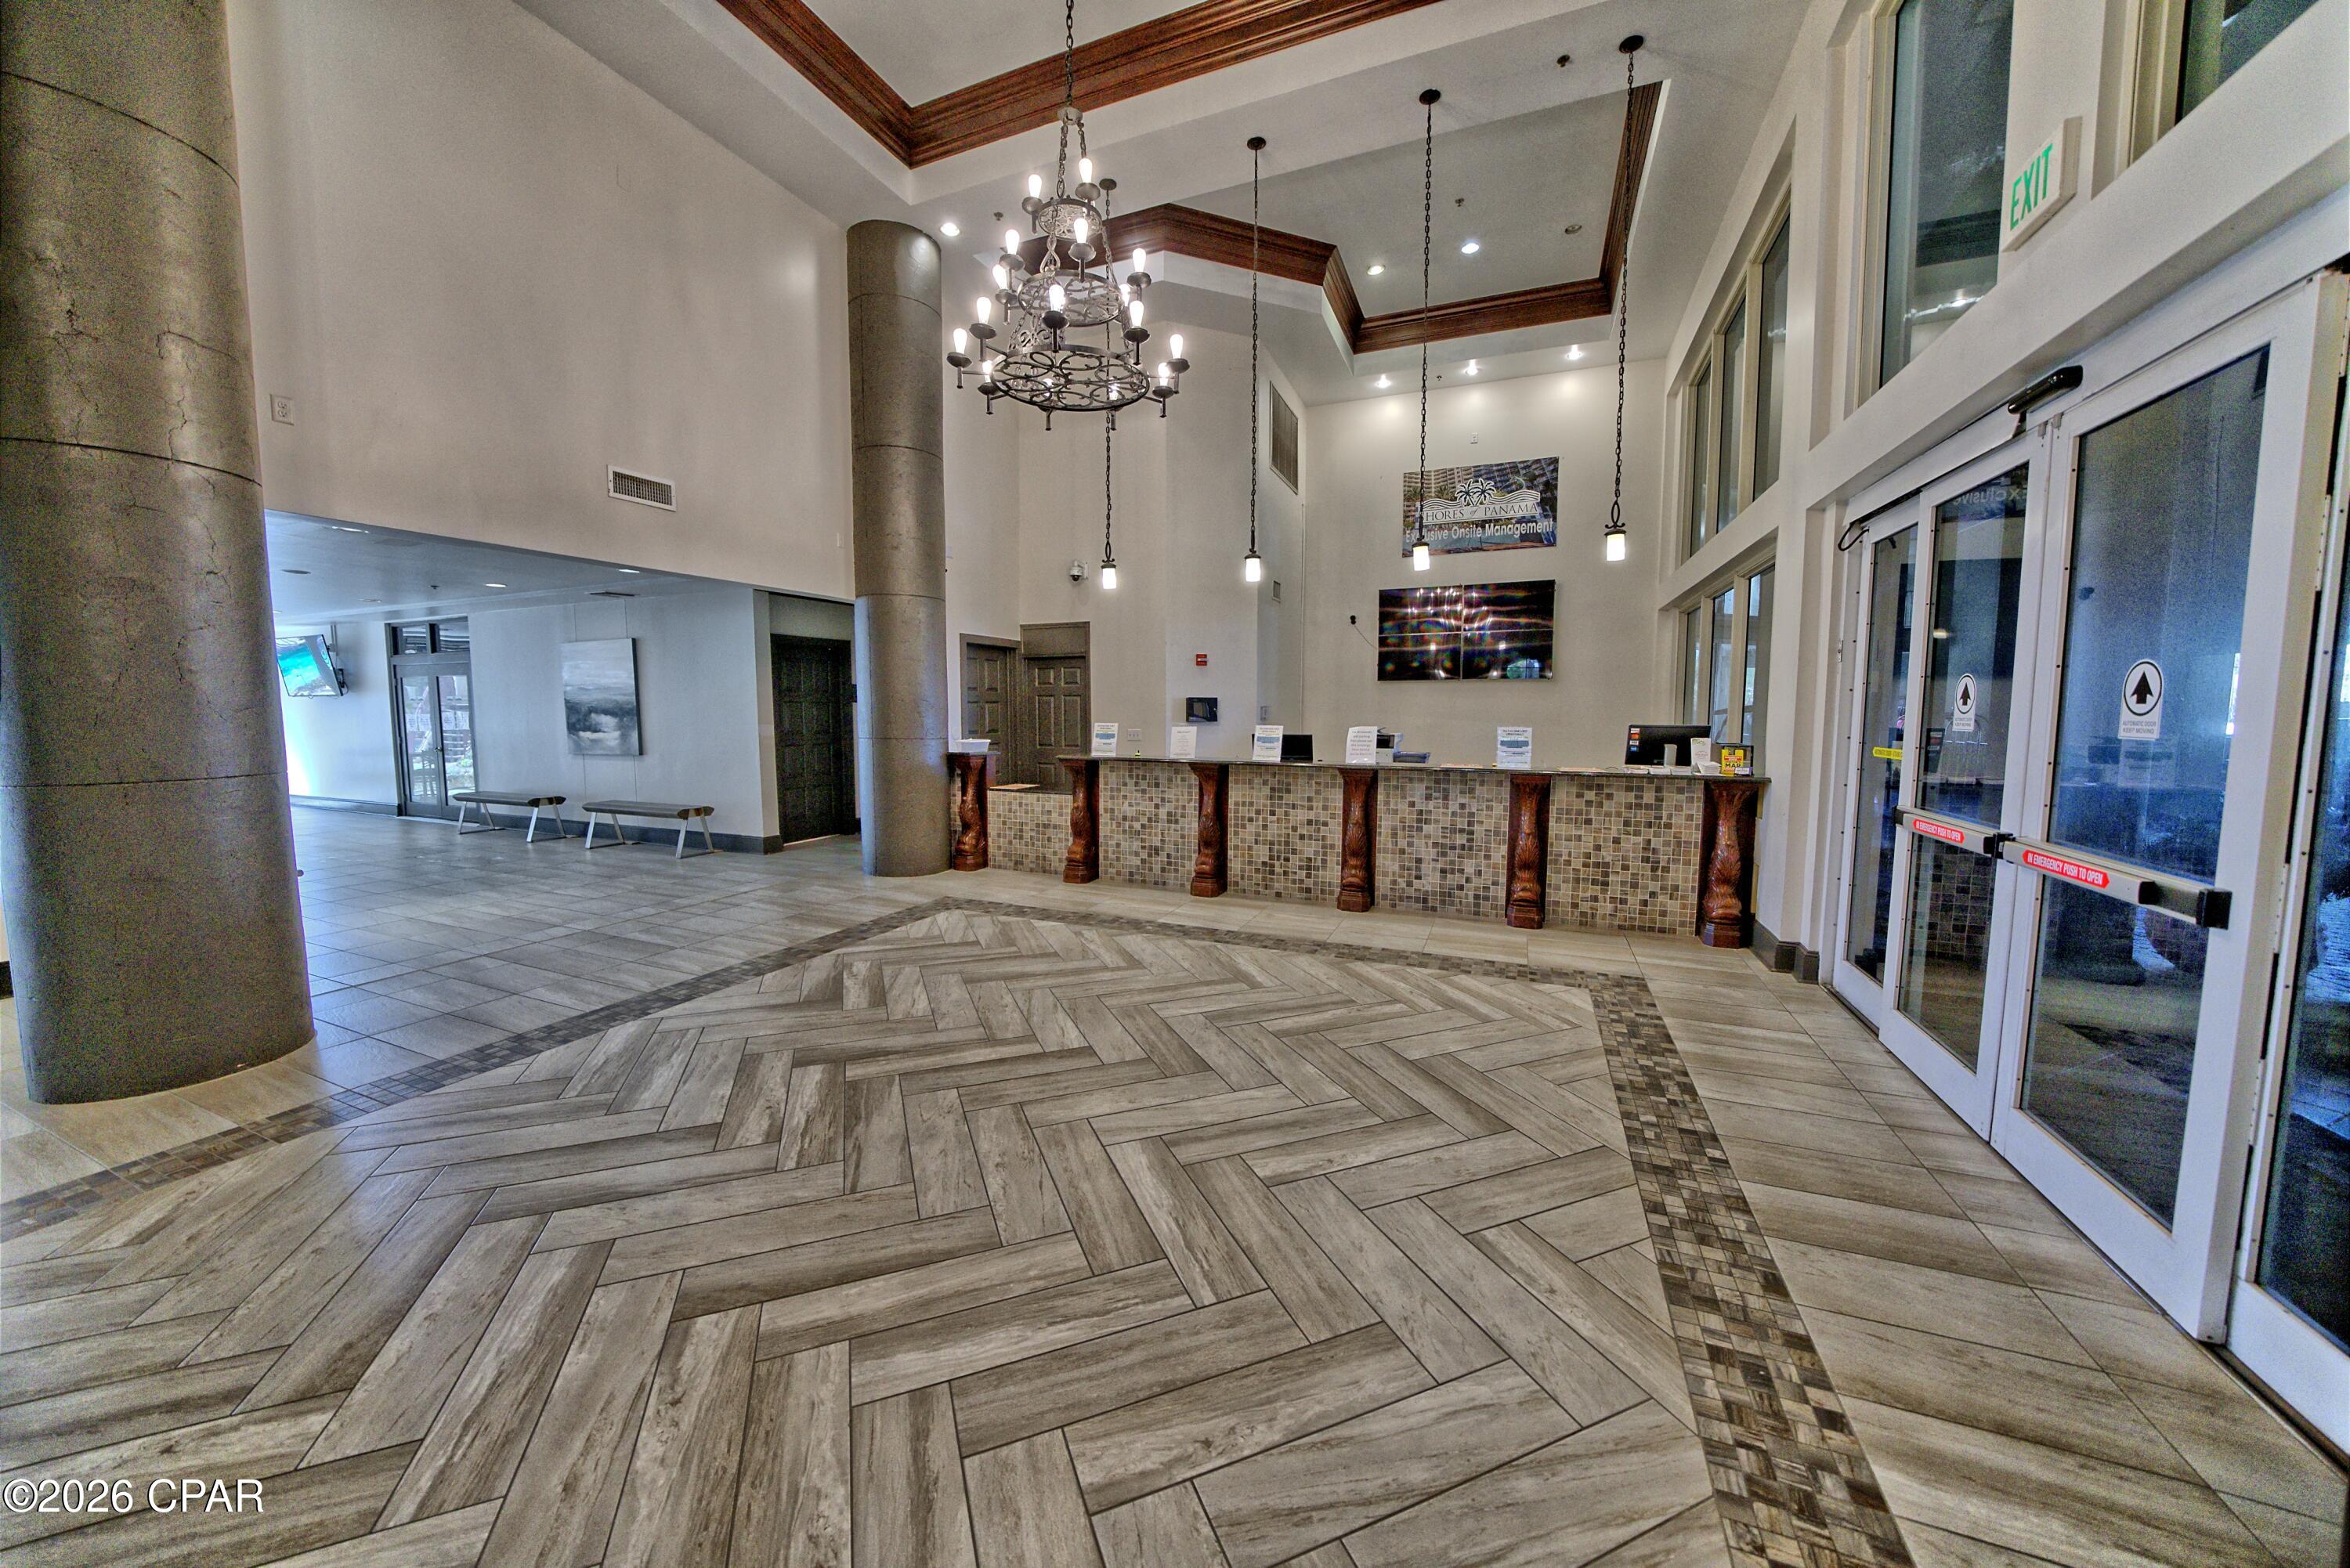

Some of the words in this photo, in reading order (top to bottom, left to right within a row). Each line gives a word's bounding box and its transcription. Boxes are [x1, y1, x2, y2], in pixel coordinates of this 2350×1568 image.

[2010, 143, 2053, 231] EXIT
[1423, 508, 1464, 522] HORES
[1470, 507, 1480, 517] of
[1484, 503, 1538, 516] PANAMA
[1452, 524, 1482, 539] Onsite
[1485, 518, 1553, 538] Management
[1919, 822, 1937, 834] EMERGENCY
[1937, 826, 1947, 836] PUSH
[1951, 830, 1961, 840] OPEN
[2027, 853, 2034, 863] IN
[2034, 854, 2063, 873] EMERGENCY
[2063, 863, 2078, 877] PUSH
[2079, 867, 2087, 880] TO
[2087, 870, 2103, 885] OPEN
